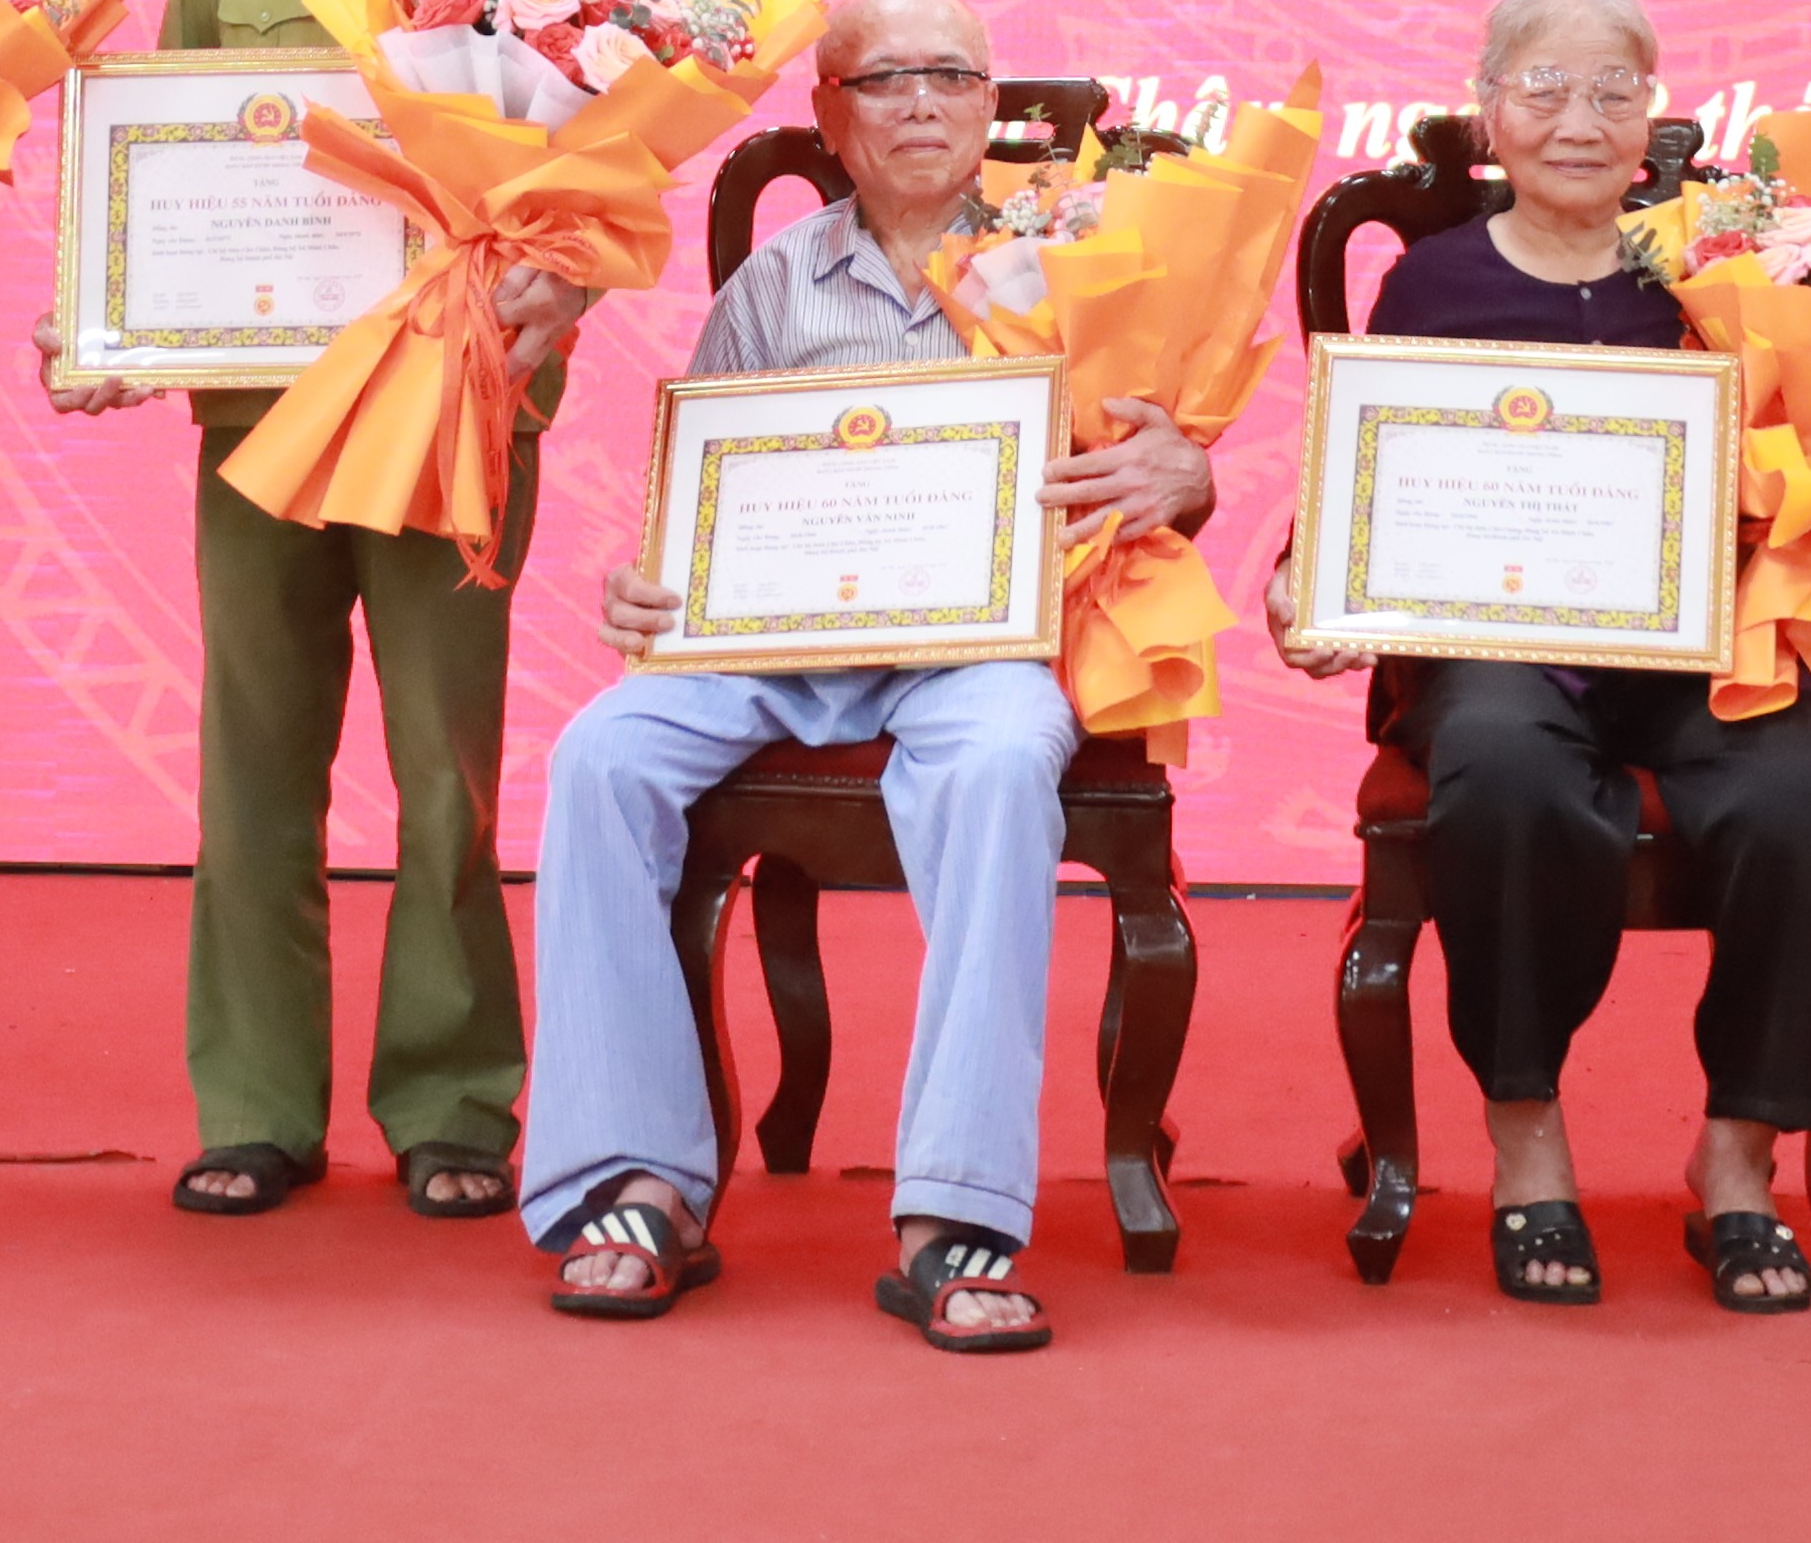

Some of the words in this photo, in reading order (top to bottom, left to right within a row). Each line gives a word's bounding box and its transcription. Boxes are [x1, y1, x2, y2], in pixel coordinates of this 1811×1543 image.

[1095, 74, 1286, 156] hâ
[150, 198, 183, 211] HUY
[188, 195, 228, 213] HIỆU
[232, 198, 248, 209] 55
[251, 195, 288, 209] NĂM
[264, 216, 299, 227] DANH
[1398, 475, 1432, 490] HUY
[1438, 477, 1479, 493] HIỆU
[1483, 480, 1500, 492] 60
[1503, 481, 1542, 496] NĂM
[739, 501, 773, 515] HUY
[778, 497, 818, 512] HIỆU
[821, 498, 837, 509] 60
[841, 494, 879, 508] NĂM
